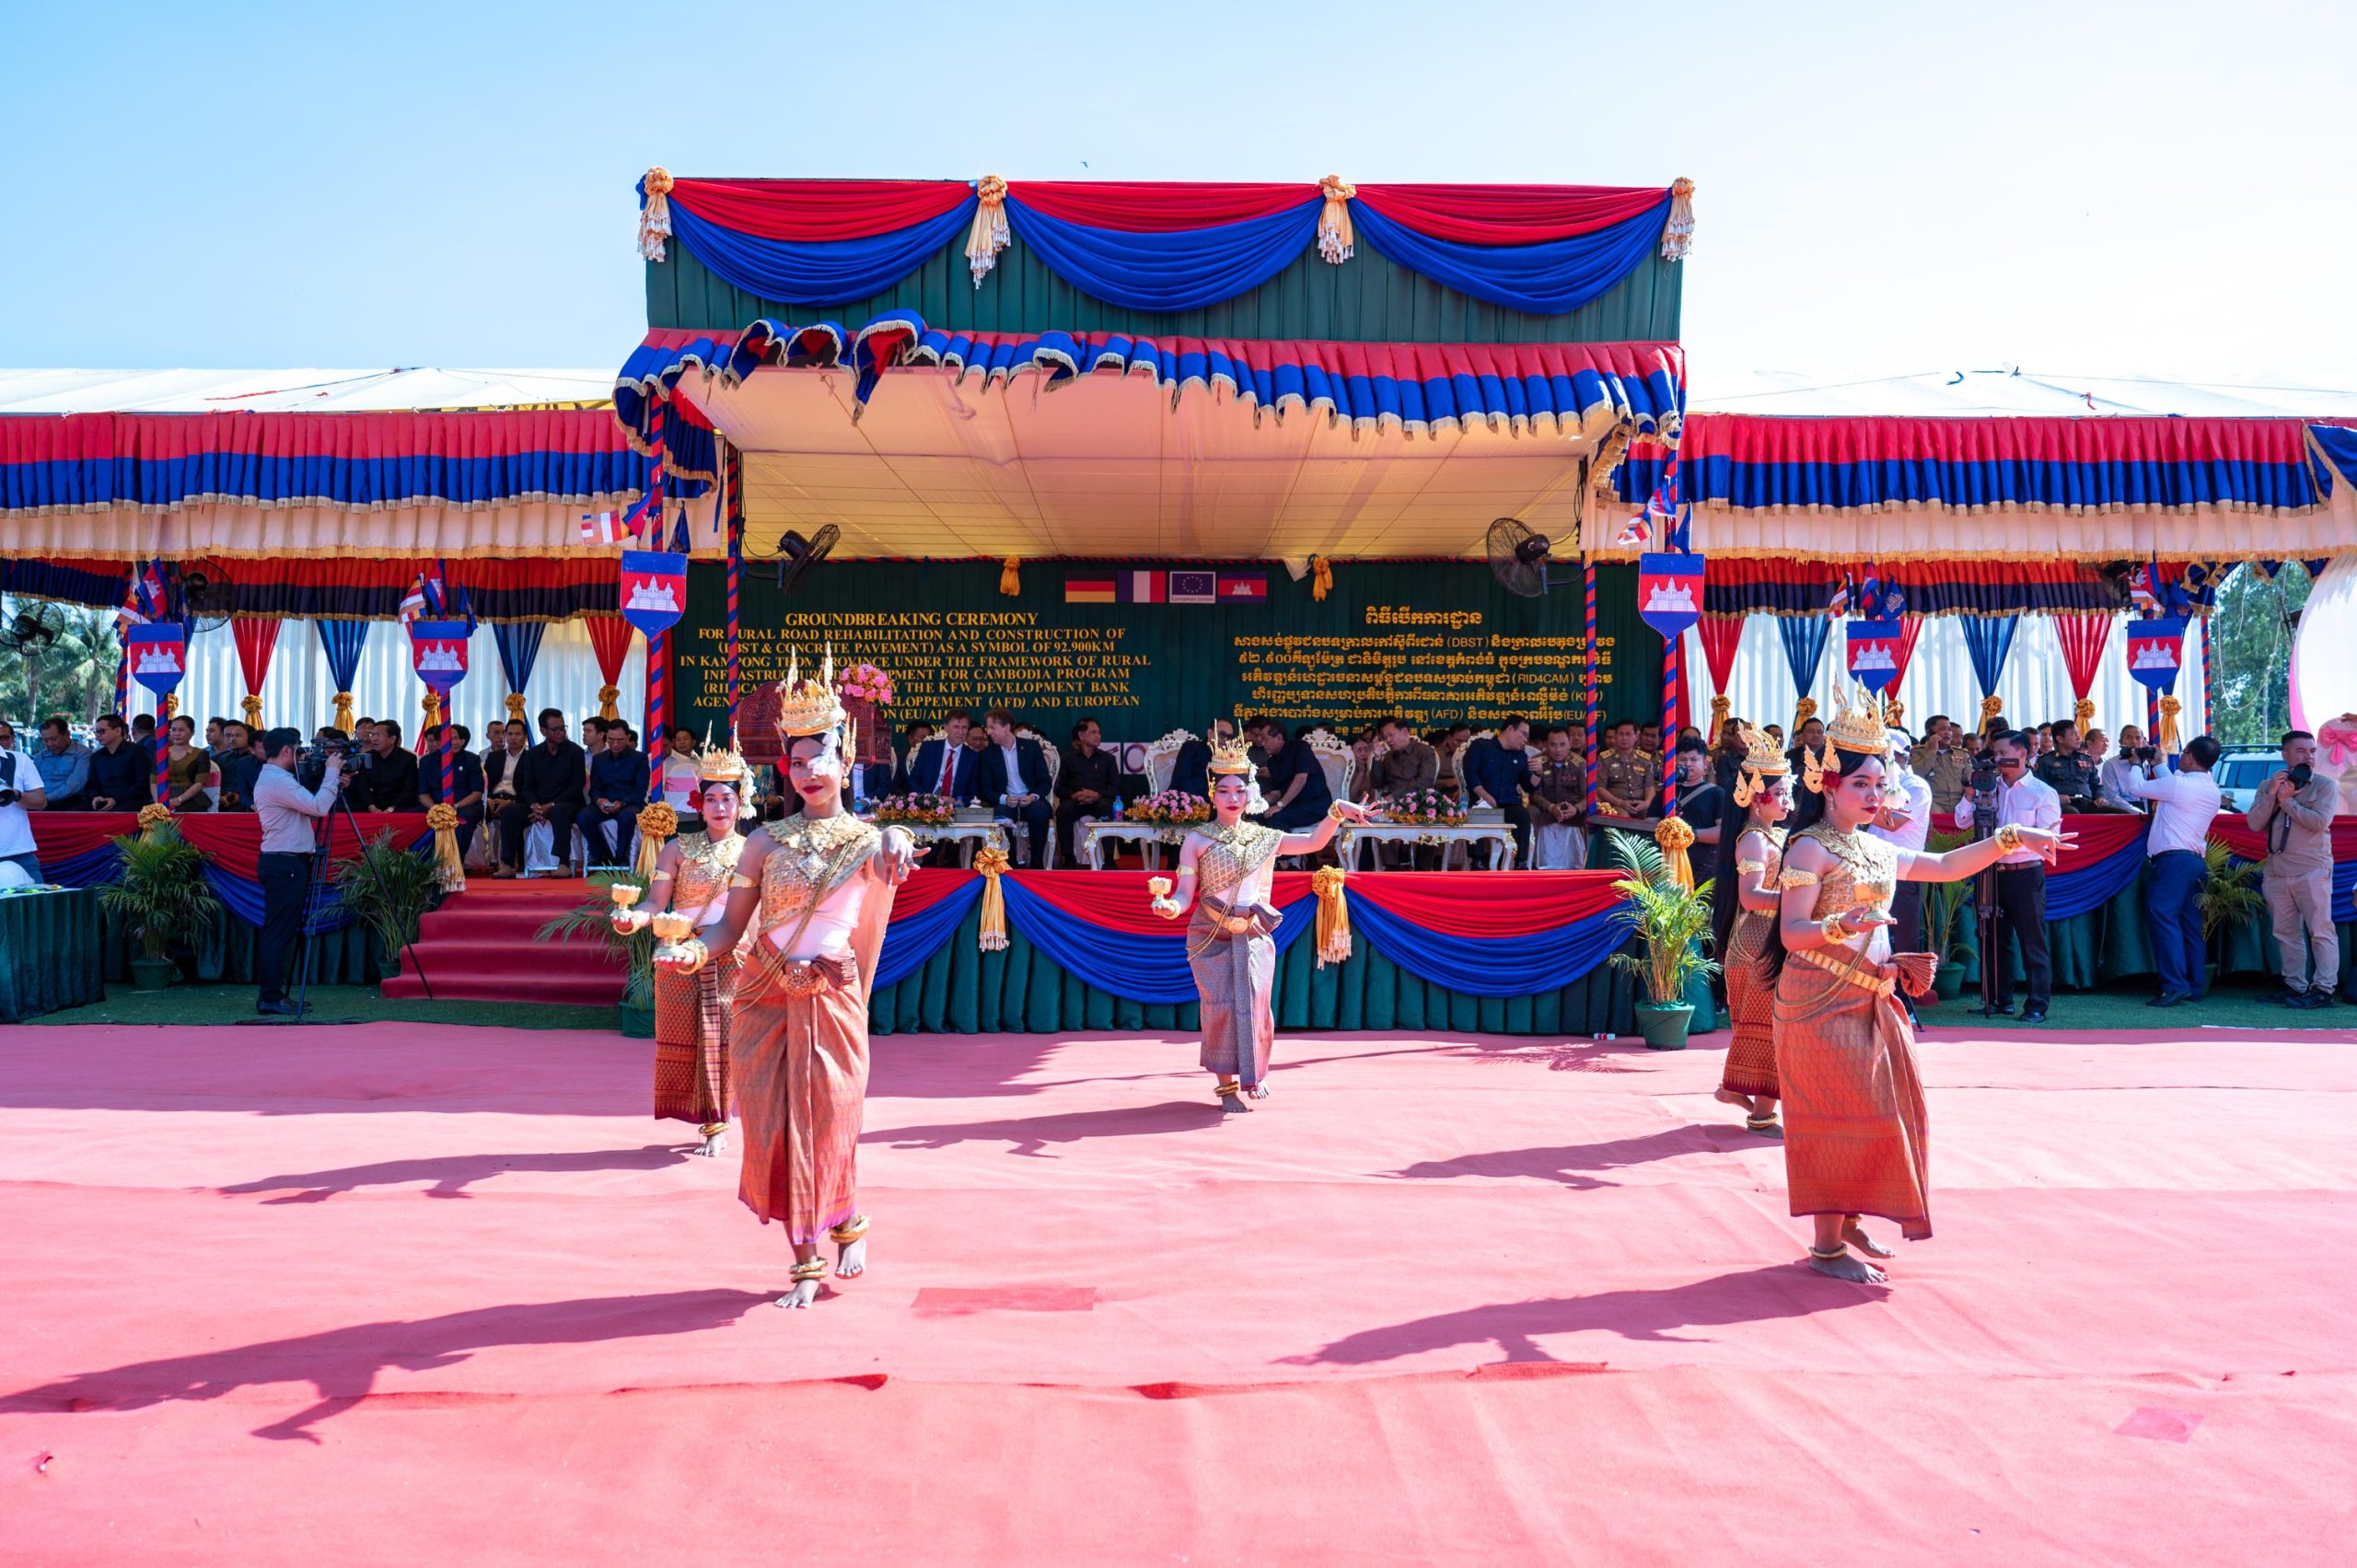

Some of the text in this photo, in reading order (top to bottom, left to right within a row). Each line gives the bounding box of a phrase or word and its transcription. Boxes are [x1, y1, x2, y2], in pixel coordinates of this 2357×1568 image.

[784, 612, 1038, 626] GROUNDBREAKING CEREMONY
[698, 628, 1126, 641] FOR URAL ROAD REHABILITATION AND CONSTRUCTION OF
[761, 642, 772, 654] &
[854, 643, 935, 655] PAVEMENT)
[937, 643, 955, 654] AS
[958, 643, 967, 654] A
[971, 643, 1029, 654] SYMBOL
[1032, 642, 1052, 653] OF
[1053, 641, 1115, 653] 92.900KM
[1446, 636, 1490, 648] (DBST)
[679, 656, 695, 667] IN
[894, 656, 942, 668] UNDER
[946, 656, 975, 668] THE
[980, 656, 1073, 668] FRAMEWORK
[1076, 656, 1097, 667] OF
[1102, 655, 1151, 667] RURAL
[703, 669, 824, 680] INFASTRUCUR
[941, 669, 969, 680] FOR
[973, 668, 1051, 680] CAMBODIA
[1056, 668, 1131, 679] PROGRAM
[1512, 673, 1574, 685] (RID4CAM)
[906, 683, 935, 694] THE
[939, 683, 972, 693] KFW
[978, 682, 1085, 693] DEVELOPMENT
[1091, 681, 1130, 692] BANK
[693, 696, 744, 708] AGEN
[989, 695, 1027, 709] (AFD)
[1031, 696, 1062, 708] AND
[1066, 695, 1140, 707] EUROPEAN
[1571, 691, 1604, 703] (K)
[1431, 709, 1464, 721] (AFD)
[1563, 710, 1607, 722] (EU/F)
